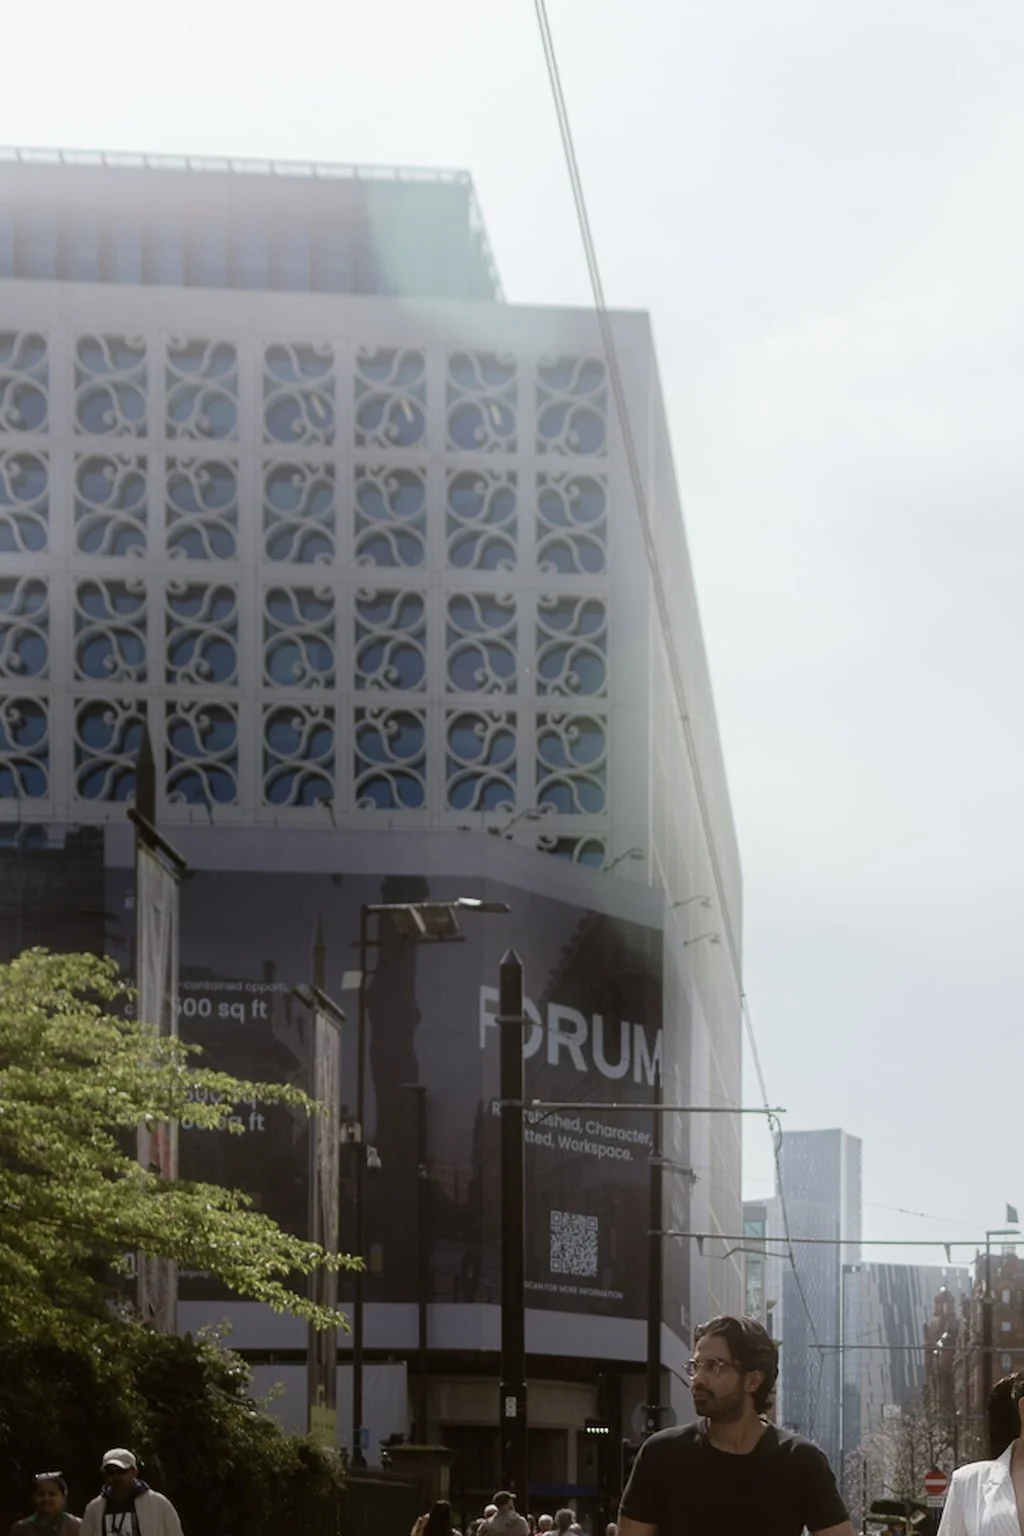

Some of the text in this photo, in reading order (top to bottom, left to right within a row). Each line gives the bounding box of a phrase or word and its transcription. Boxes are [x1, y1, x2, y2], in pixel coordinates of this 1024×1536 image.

[218, 1002, 245, 1024] sq
[251, 998, 268, 1019] ft
[249, 1111, 266, 1132] ft
[585, 1120, 653, 1147] Character,
[524, 1129, 634, 1161] tted, Workspace.
